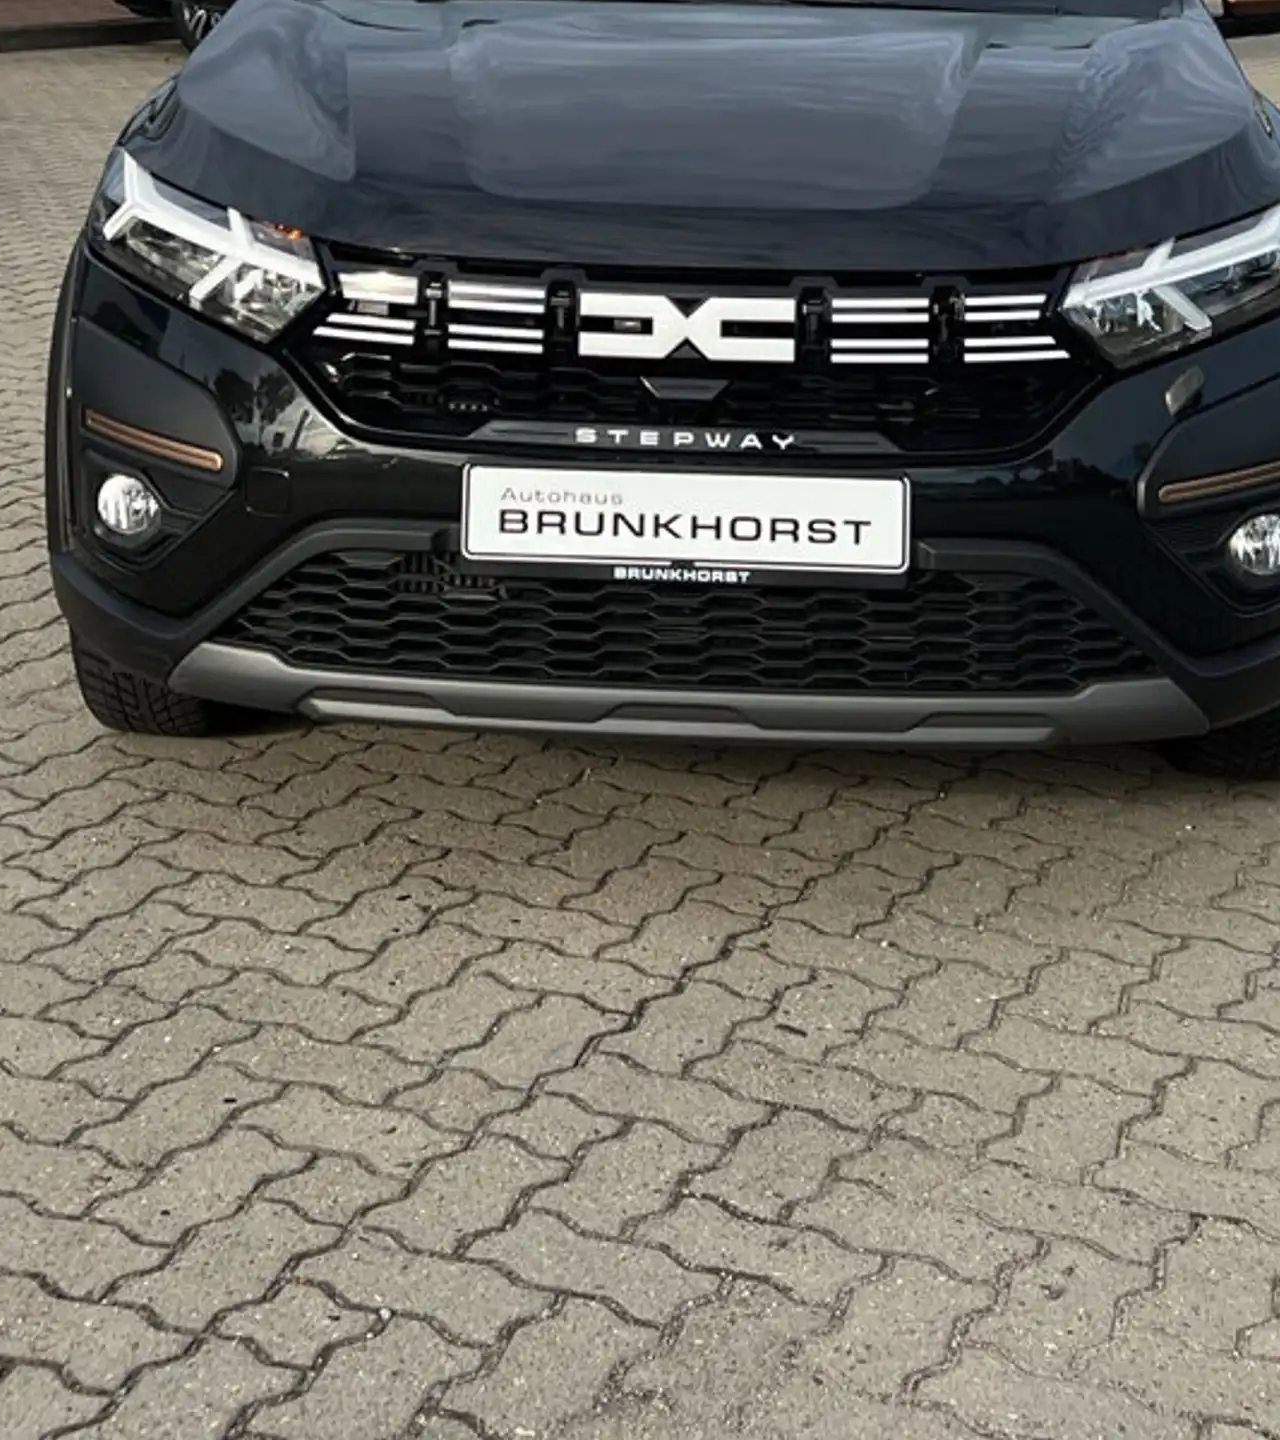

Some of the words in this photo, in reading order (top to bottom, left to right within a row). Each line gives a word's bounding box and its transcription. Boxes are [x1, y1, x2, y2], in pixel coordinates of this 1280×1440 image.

[574, 427, 797, 452] STEPWAY
[500, 486, 625, 505] Autohaus
[498, 508, 874, 546] BRUNKHORST
[613, 566, 752, 583] BRUNKHORST
